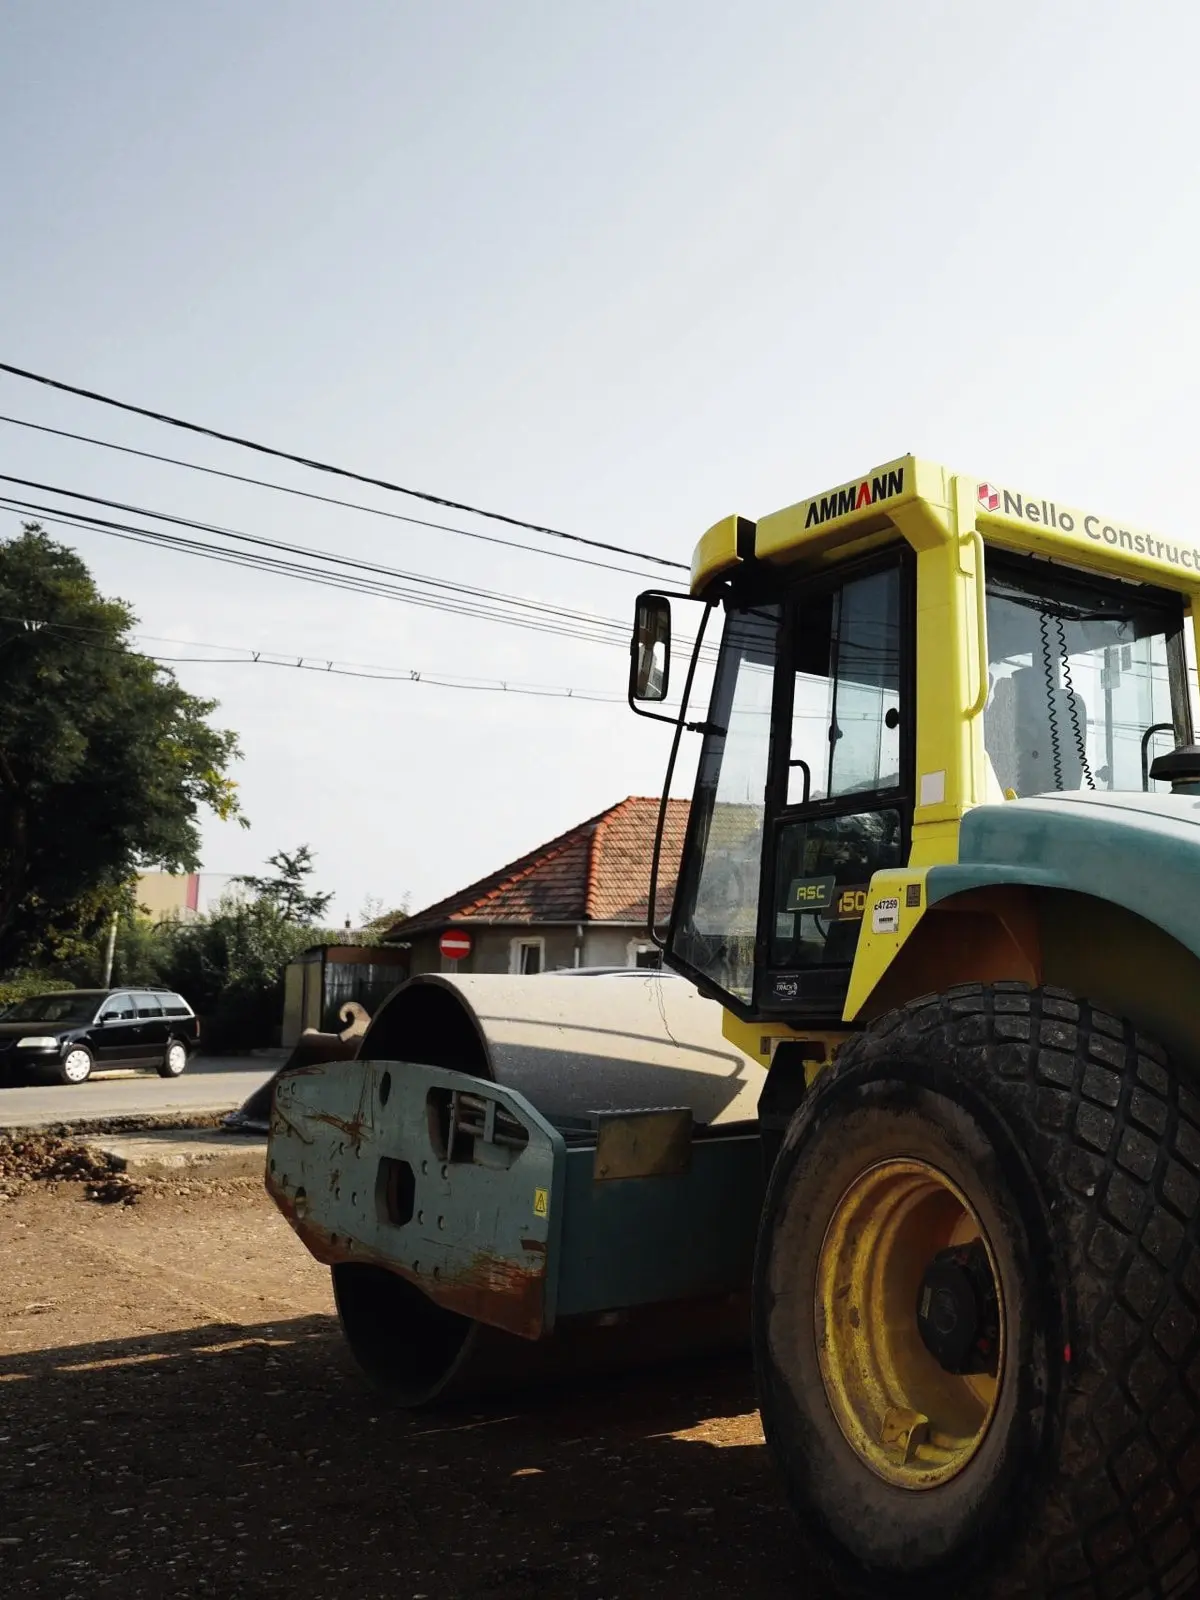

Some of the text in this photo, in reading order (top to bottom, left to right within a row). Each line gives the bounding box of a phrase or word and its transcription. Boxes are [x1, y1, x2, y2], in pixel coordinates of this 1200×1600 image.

[804, 467, 904, 529] AMMANN
[1003, 489, 1075, 532] Nello
[796, 884, 825, 901] ASC
